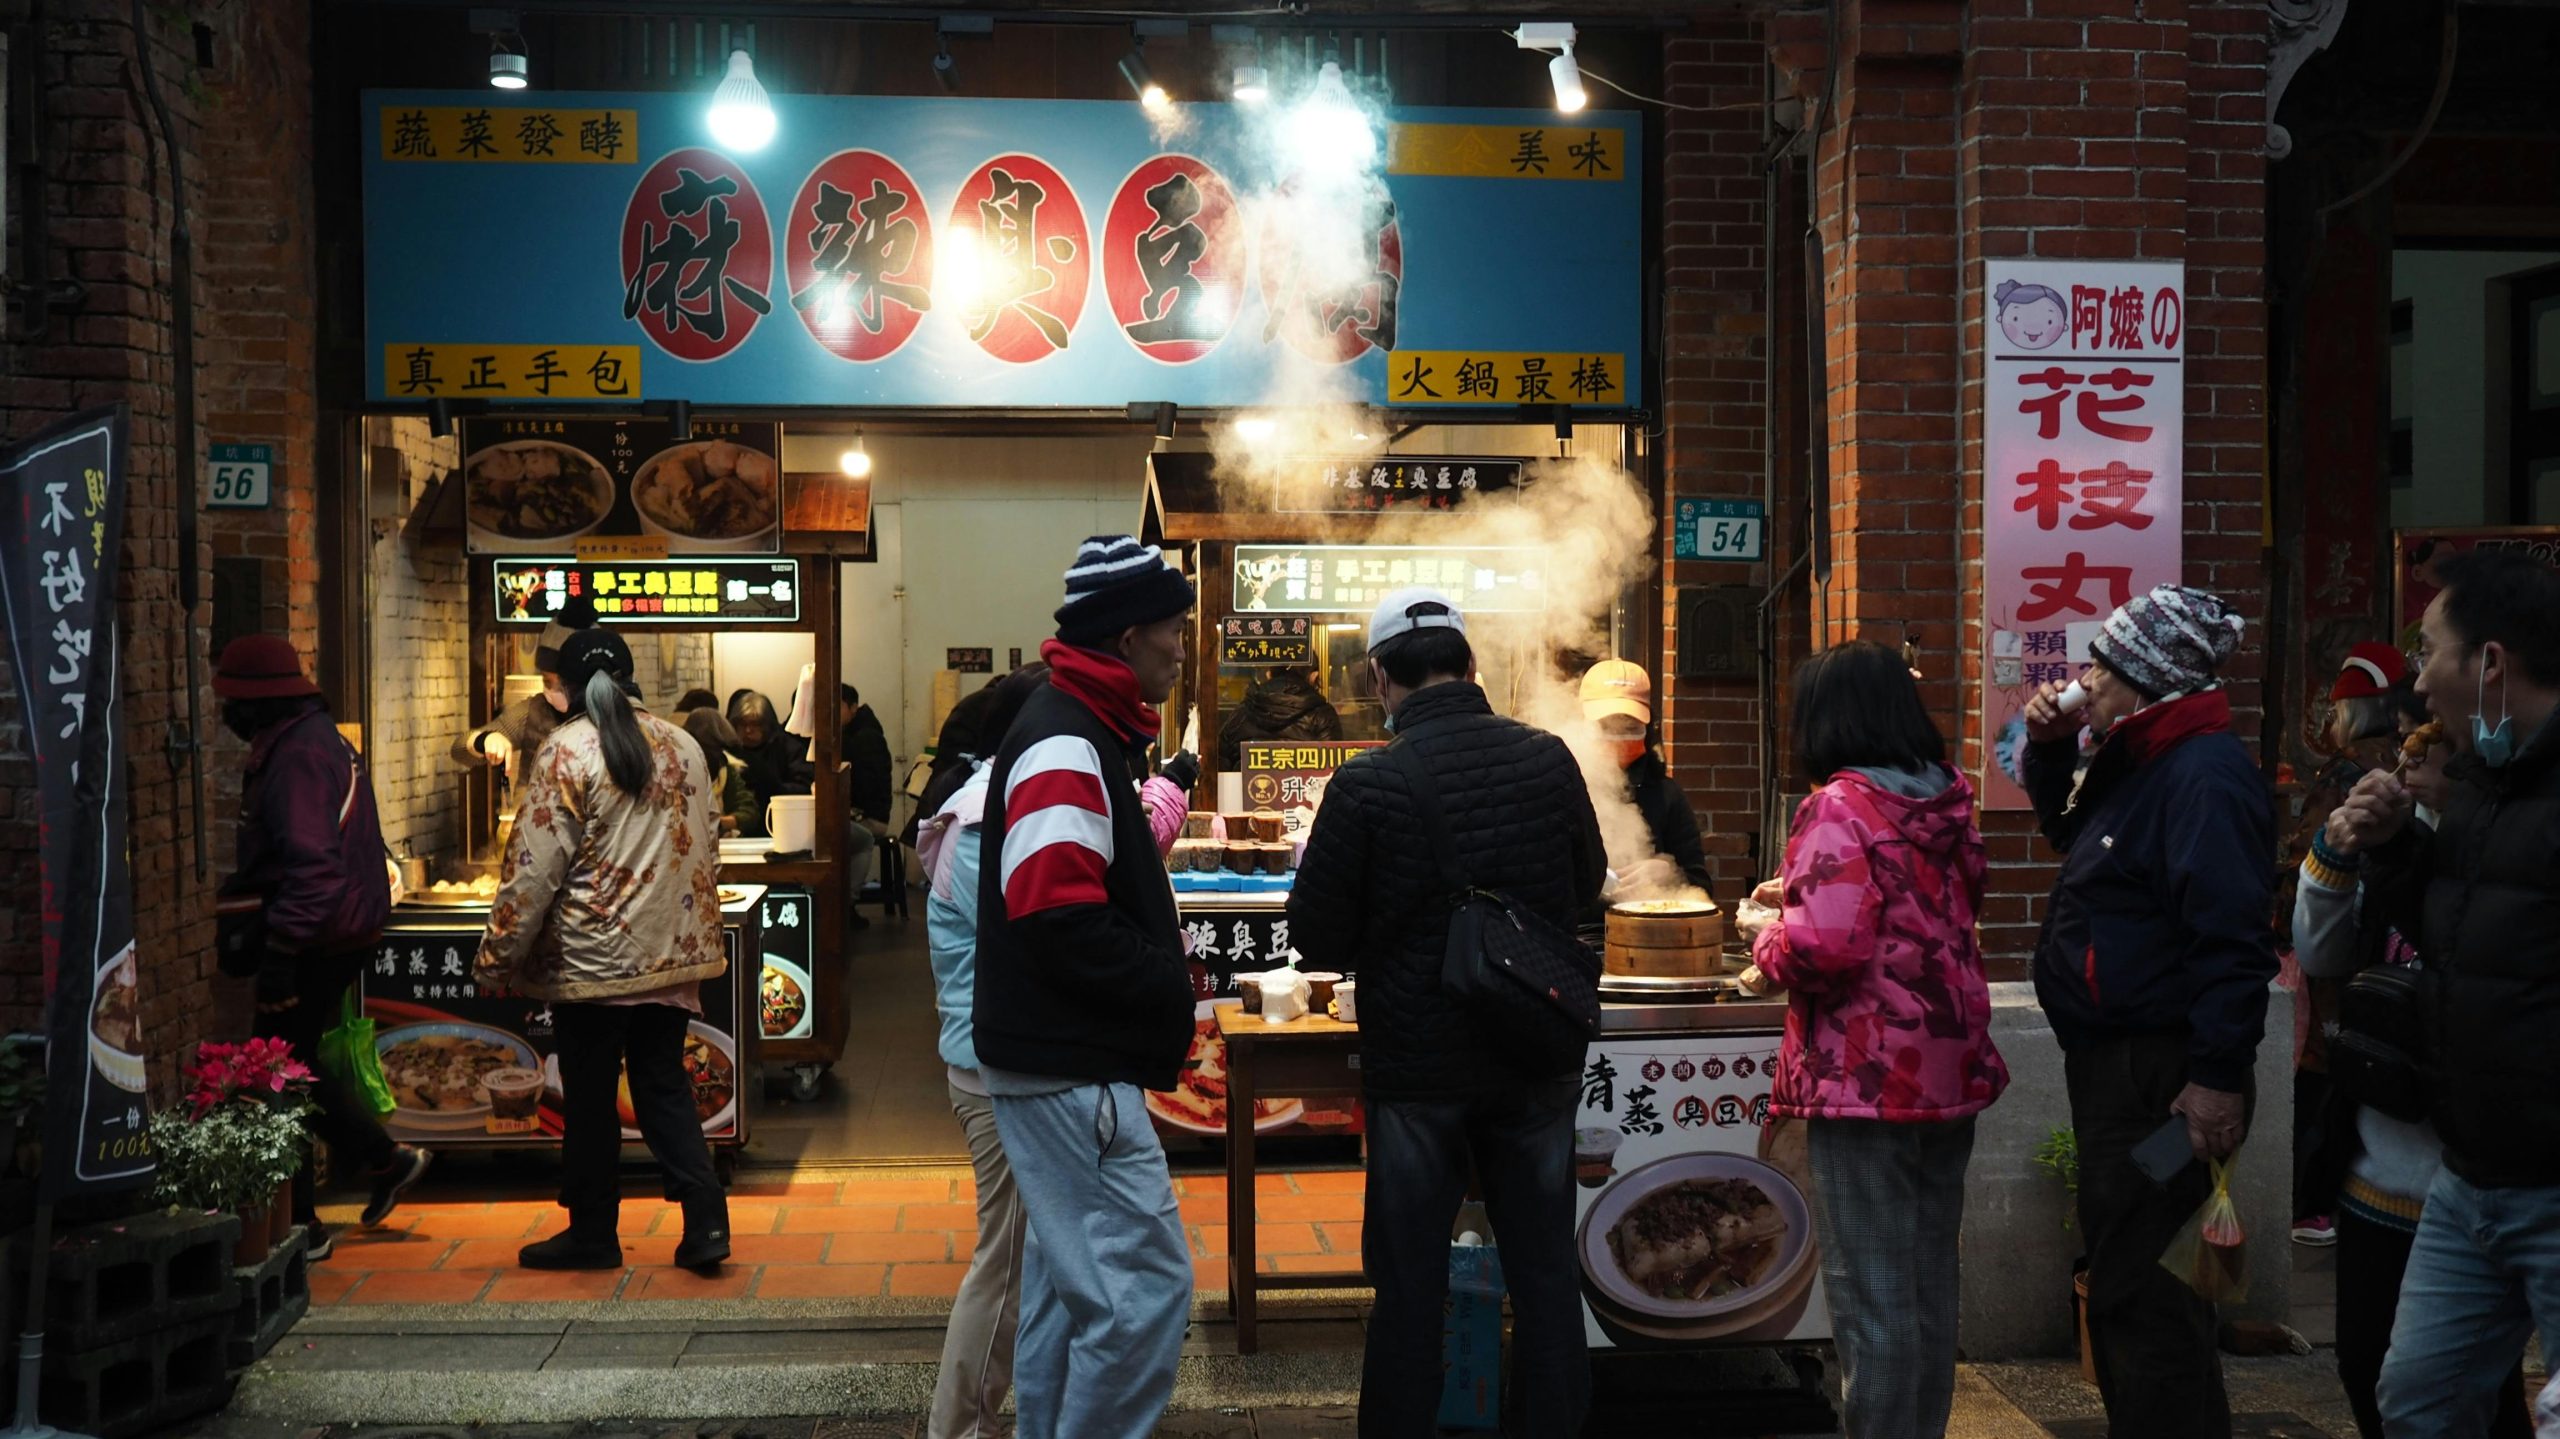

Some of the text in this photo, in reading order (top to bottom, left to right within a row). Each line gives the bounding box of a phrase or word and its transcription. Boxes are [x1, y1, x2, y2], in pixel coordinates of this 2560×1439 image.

[390, 110, 625, 161] 蔬菜發酵
[2071, 283, 2182, 351] 阿嬤の
[398, 346, 629, 395] 真正手包
[1400, 356, 1616, 399] 火鍋最棒
[213, 466, 255, 500] 56
[2013, 366, 2155, 623] 花枝丸
[1712, 521, 1749, 553] 54
[374, 946, 464, 977] 清蒸臭
